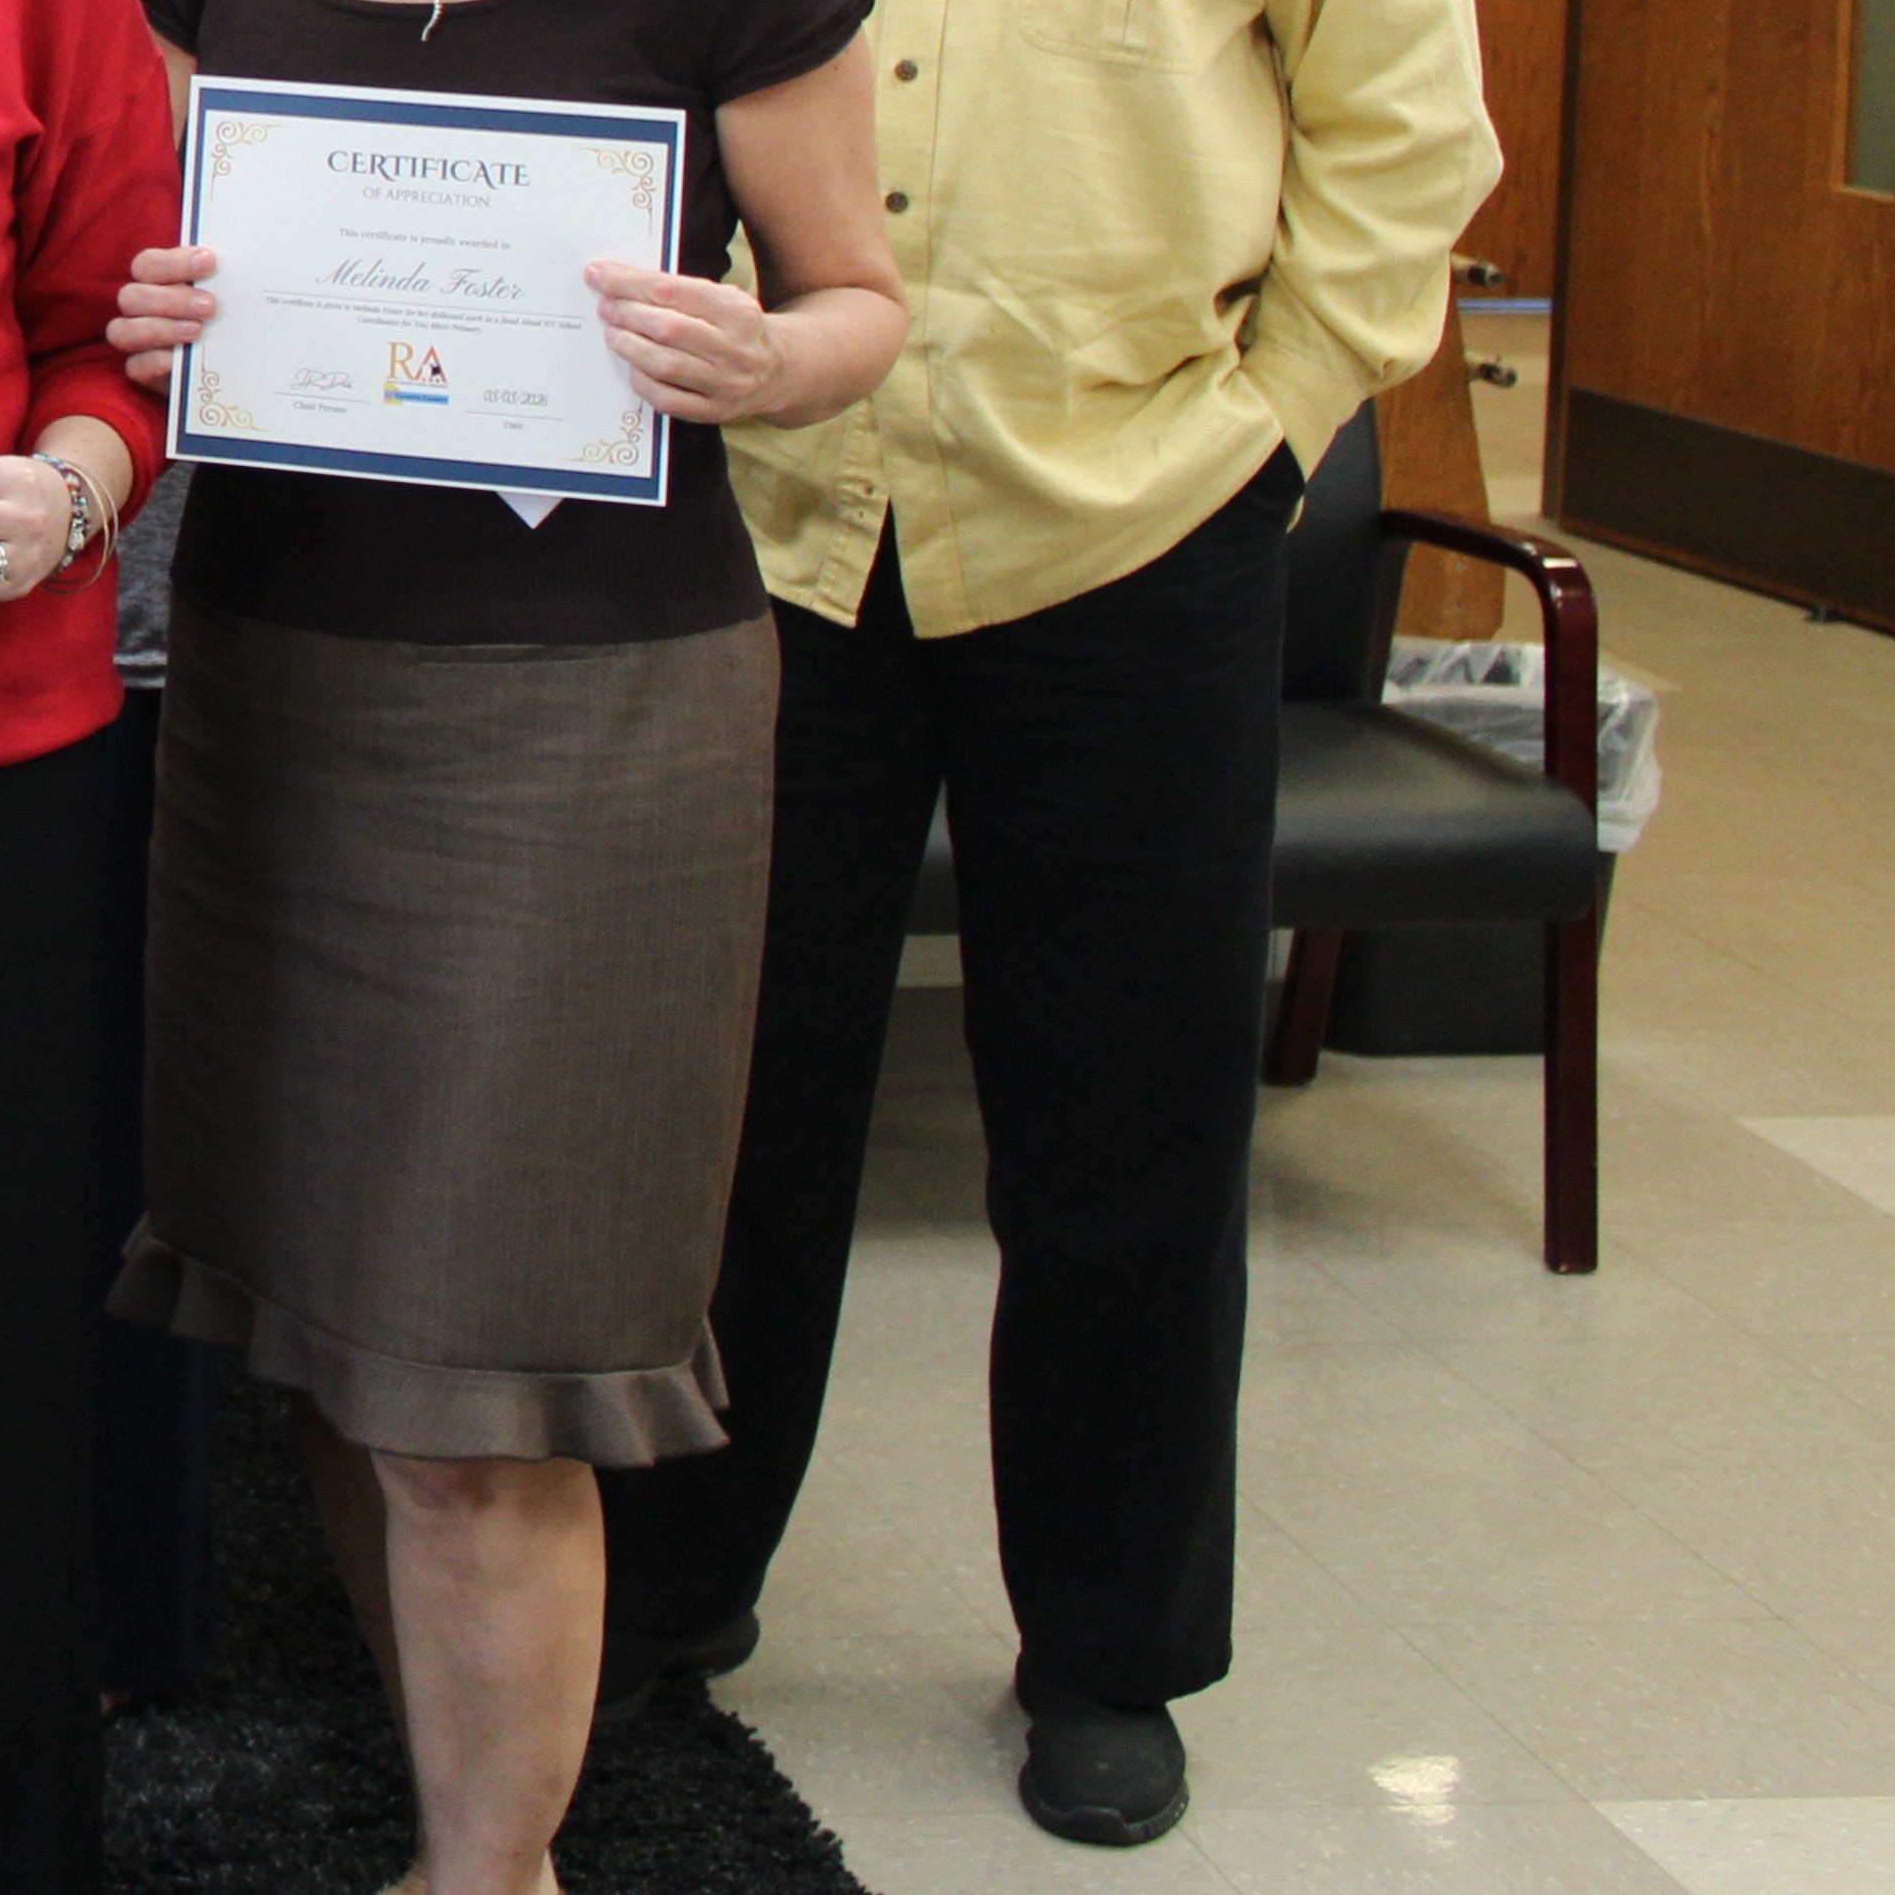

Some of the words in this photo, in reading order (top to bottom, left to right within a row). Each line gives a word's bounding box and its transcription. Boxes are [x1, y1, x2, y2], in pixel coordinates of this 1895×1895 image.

[327, 150, 531, 190] CERTIFICATE
[362, 186, 383, 200] OF
[385, 188, 490, 208] APPRECIATION
[339, 228, 358, 238] This
[361, 230, 408, 242] certificate
[410, 233, 418, 243] is
[420, 235, 456, 247] proudly
[459, 238, 498, 250] awarded
[501, 242, 510, 250] to
[315, 258, 431, 293] Melinda
[439, 268, 525, 301] Foster
[503, 421, 523, 430] Date
